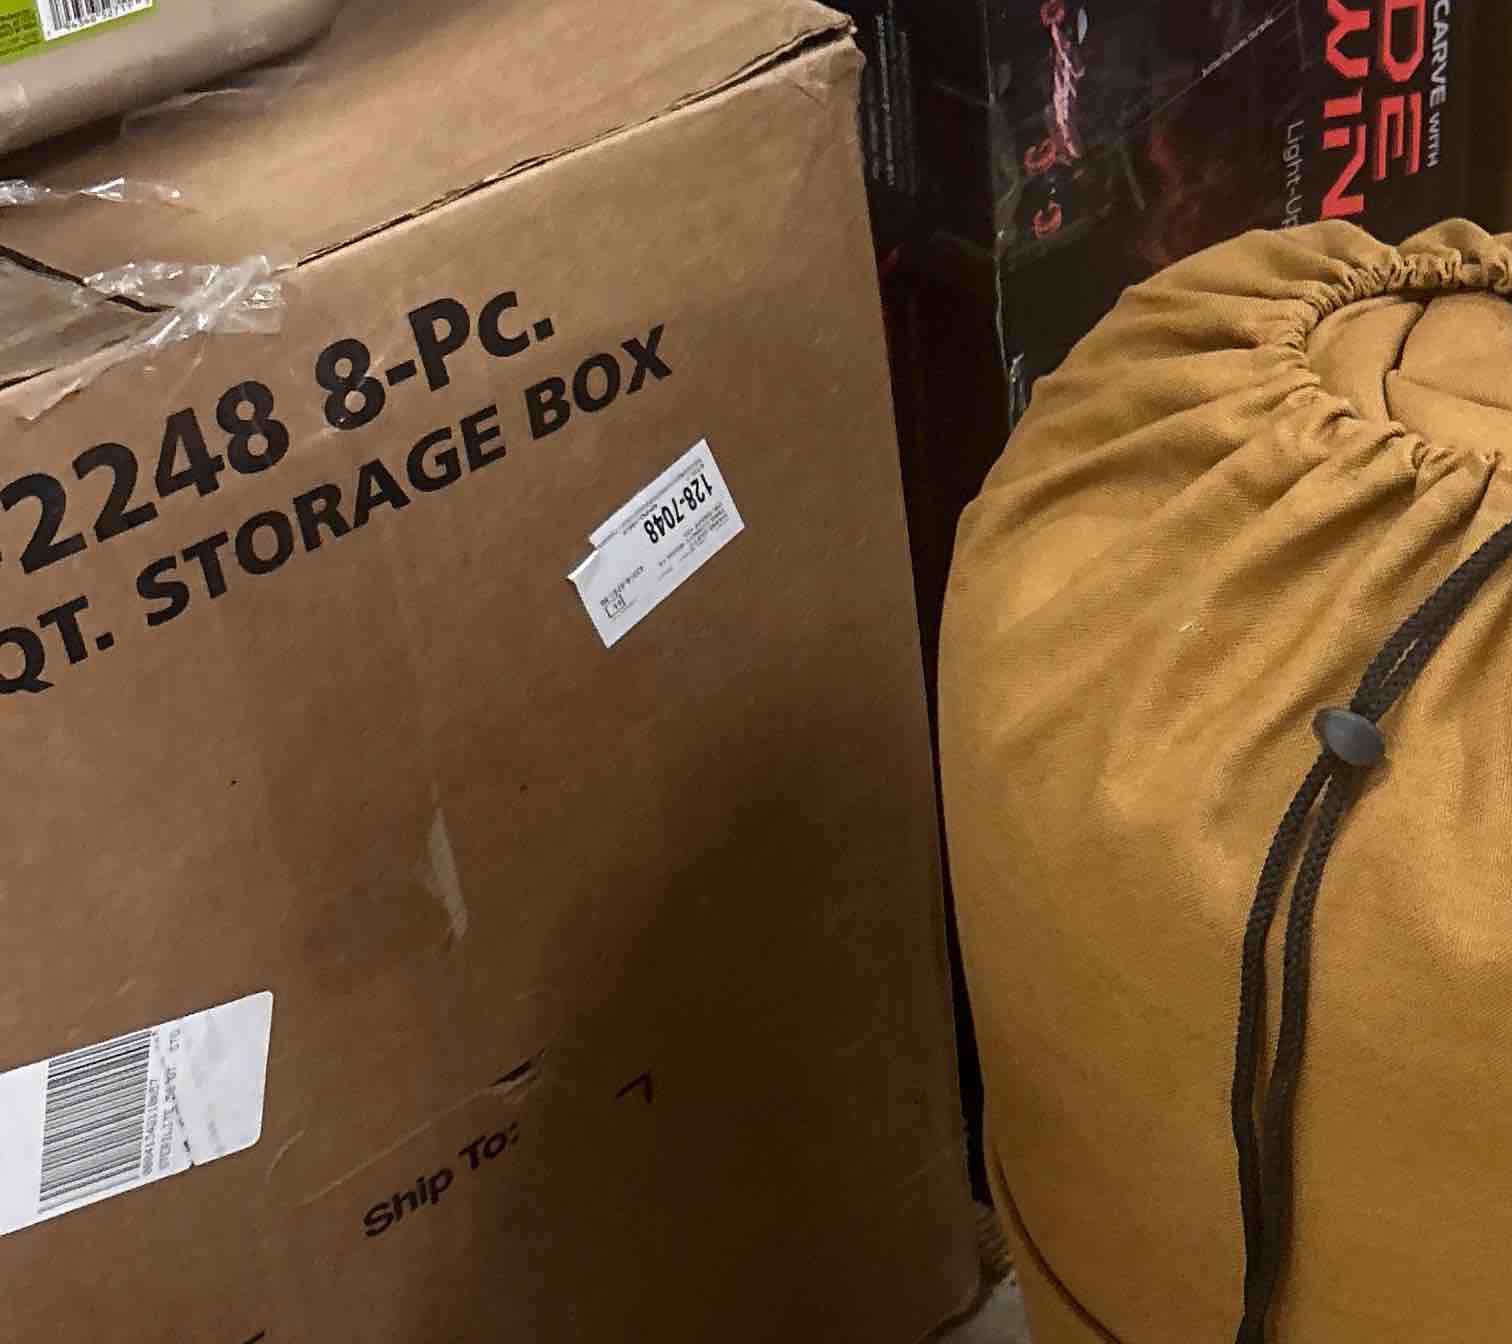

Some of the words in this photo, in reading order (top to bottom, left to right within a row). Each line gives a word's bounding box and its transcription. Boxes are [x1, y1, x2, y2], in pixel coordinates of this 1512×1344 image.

[1425, 112, 1442, 169] WITH
[0, 379, 290, 575] 2248
[315, 290, 555, 430] 8-Pc.
[136, 404, 506, 627] STORAGE
[525, 323, 673, 439] BOX
[643, 473, 713, 545] 128-7048
[363, 1166, 455, 1238] Ship
[459, 1120, 521, 1171] To:
